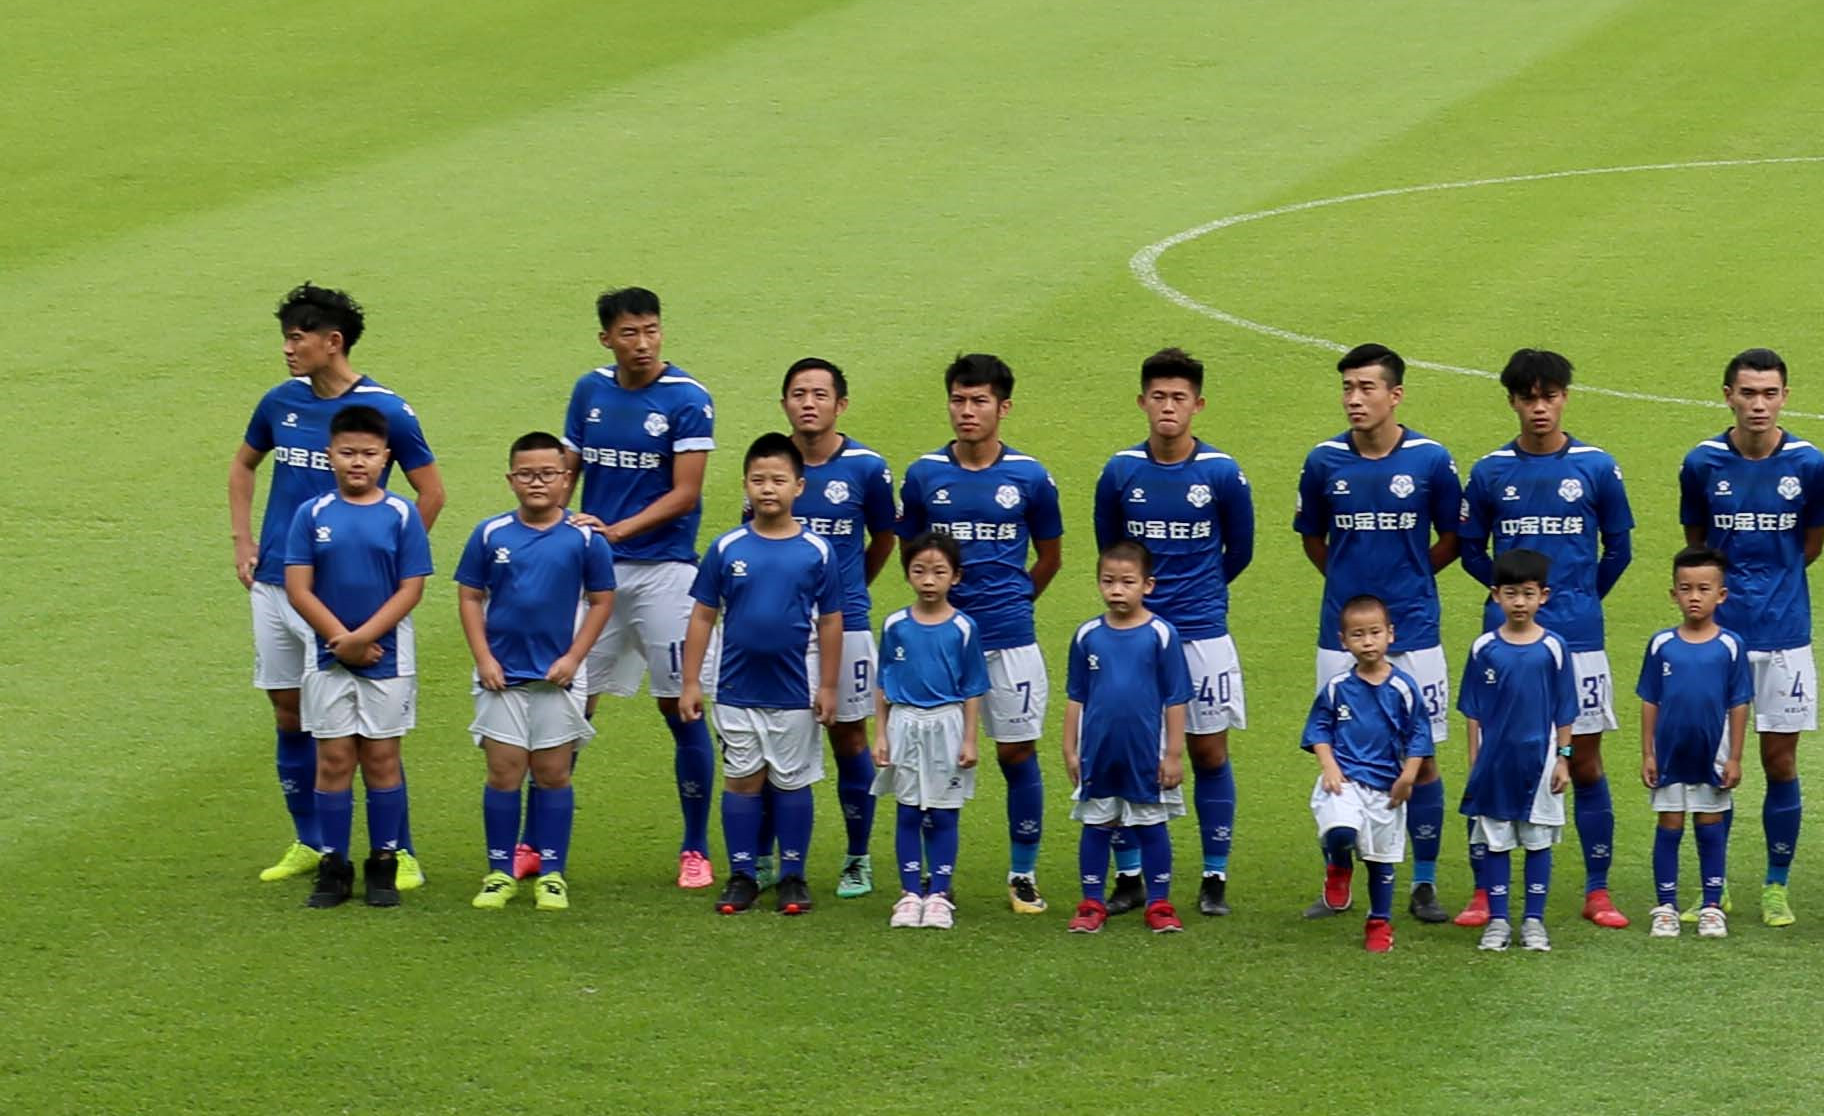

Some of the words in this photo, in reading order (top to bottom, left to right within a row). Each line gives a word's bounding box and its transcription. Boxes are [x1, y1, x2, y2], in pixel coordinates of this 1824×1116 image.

[275, 446, 336, 471] 中金在
[583, 446, 661, 468] 中金在线
[1128, 520, 1212, 540] 中金在线
[1335, 512, 1418, 532] 中金在线
[1501, 516, 1584, 536] 中金在线
[1714, 512, 1799, 532] 中金在线
[854, 659, 868, 694] 9
[1791, 670, 1805, 703] 4
[1016, 681, 1031, 714] 7
[1199, 671, 1231, 707] 40
